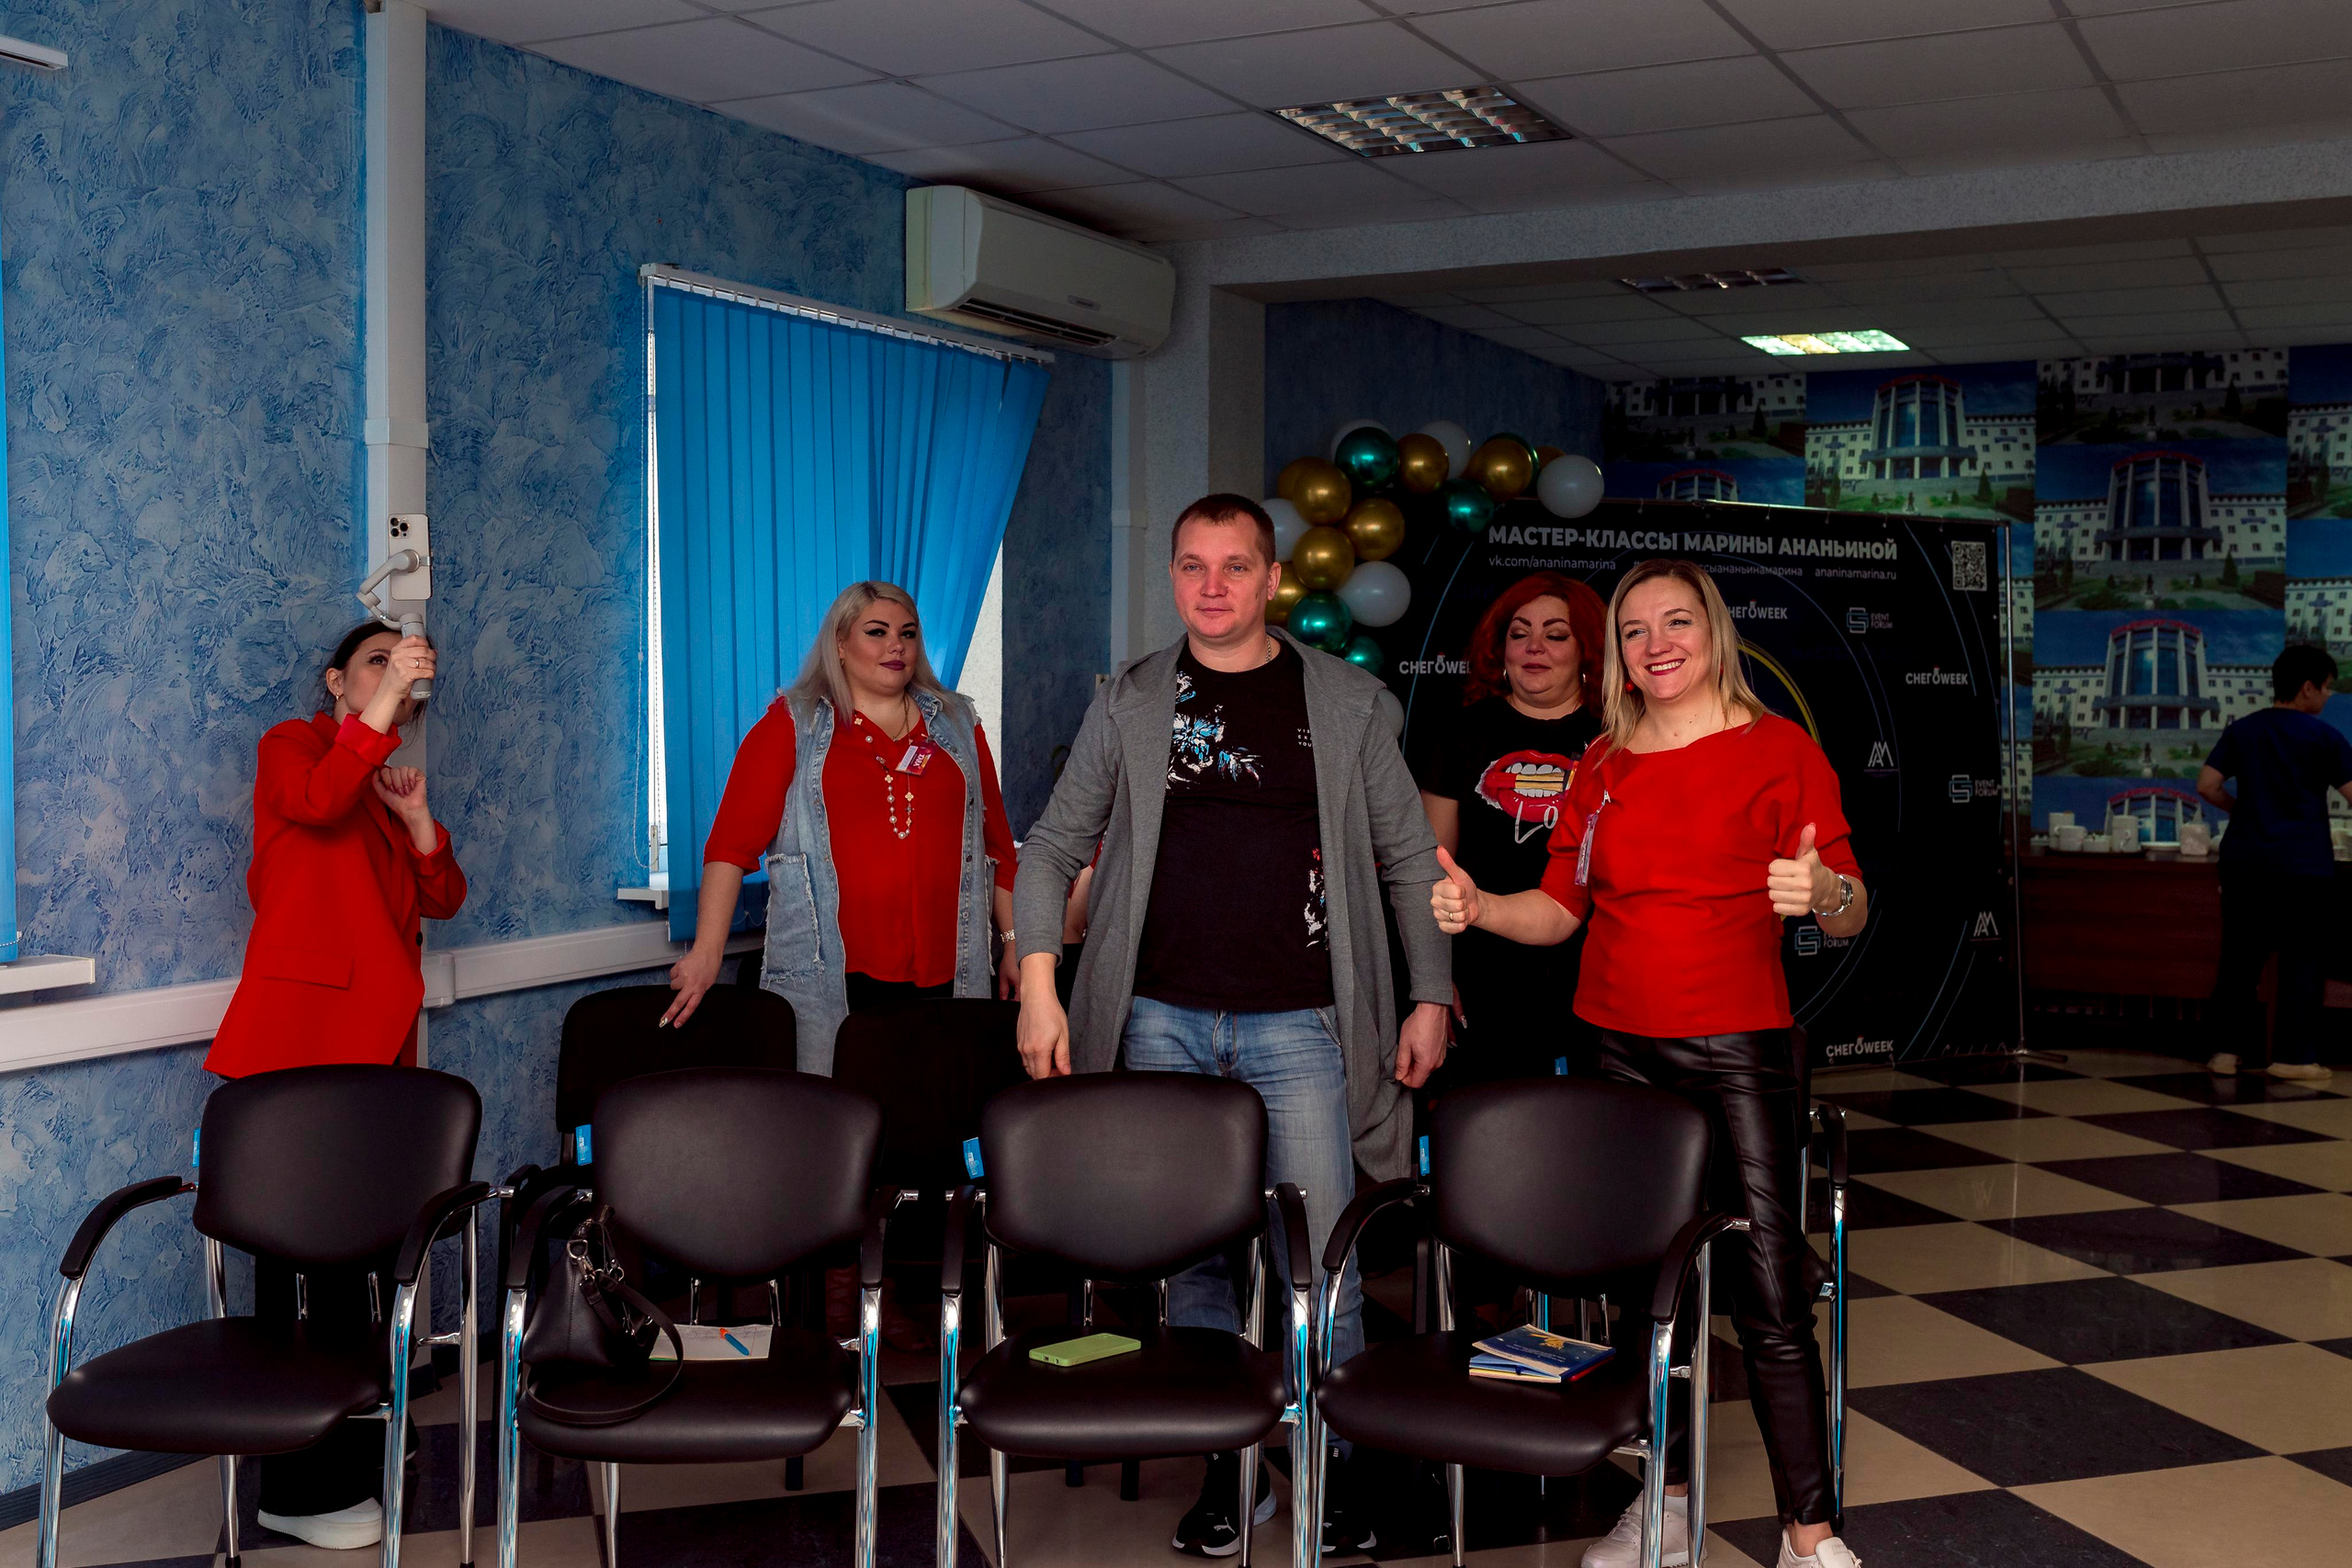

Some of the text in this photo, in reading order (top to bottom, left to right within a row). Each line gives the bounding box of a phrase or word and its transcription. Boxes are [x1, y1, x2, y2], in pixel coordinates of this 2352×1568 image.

[1488, 525, 1897, 560] МАСТЕР-КЛАССЫ МАРИНЫ АНАНЬИНОЙ
[1488, 555, 1616, 570] vk.com/ananinamarina
[1815, 566, 1897, 581] ananinamarina.ru
[1727, 604, 1789, 620] НЕГОWEEK
